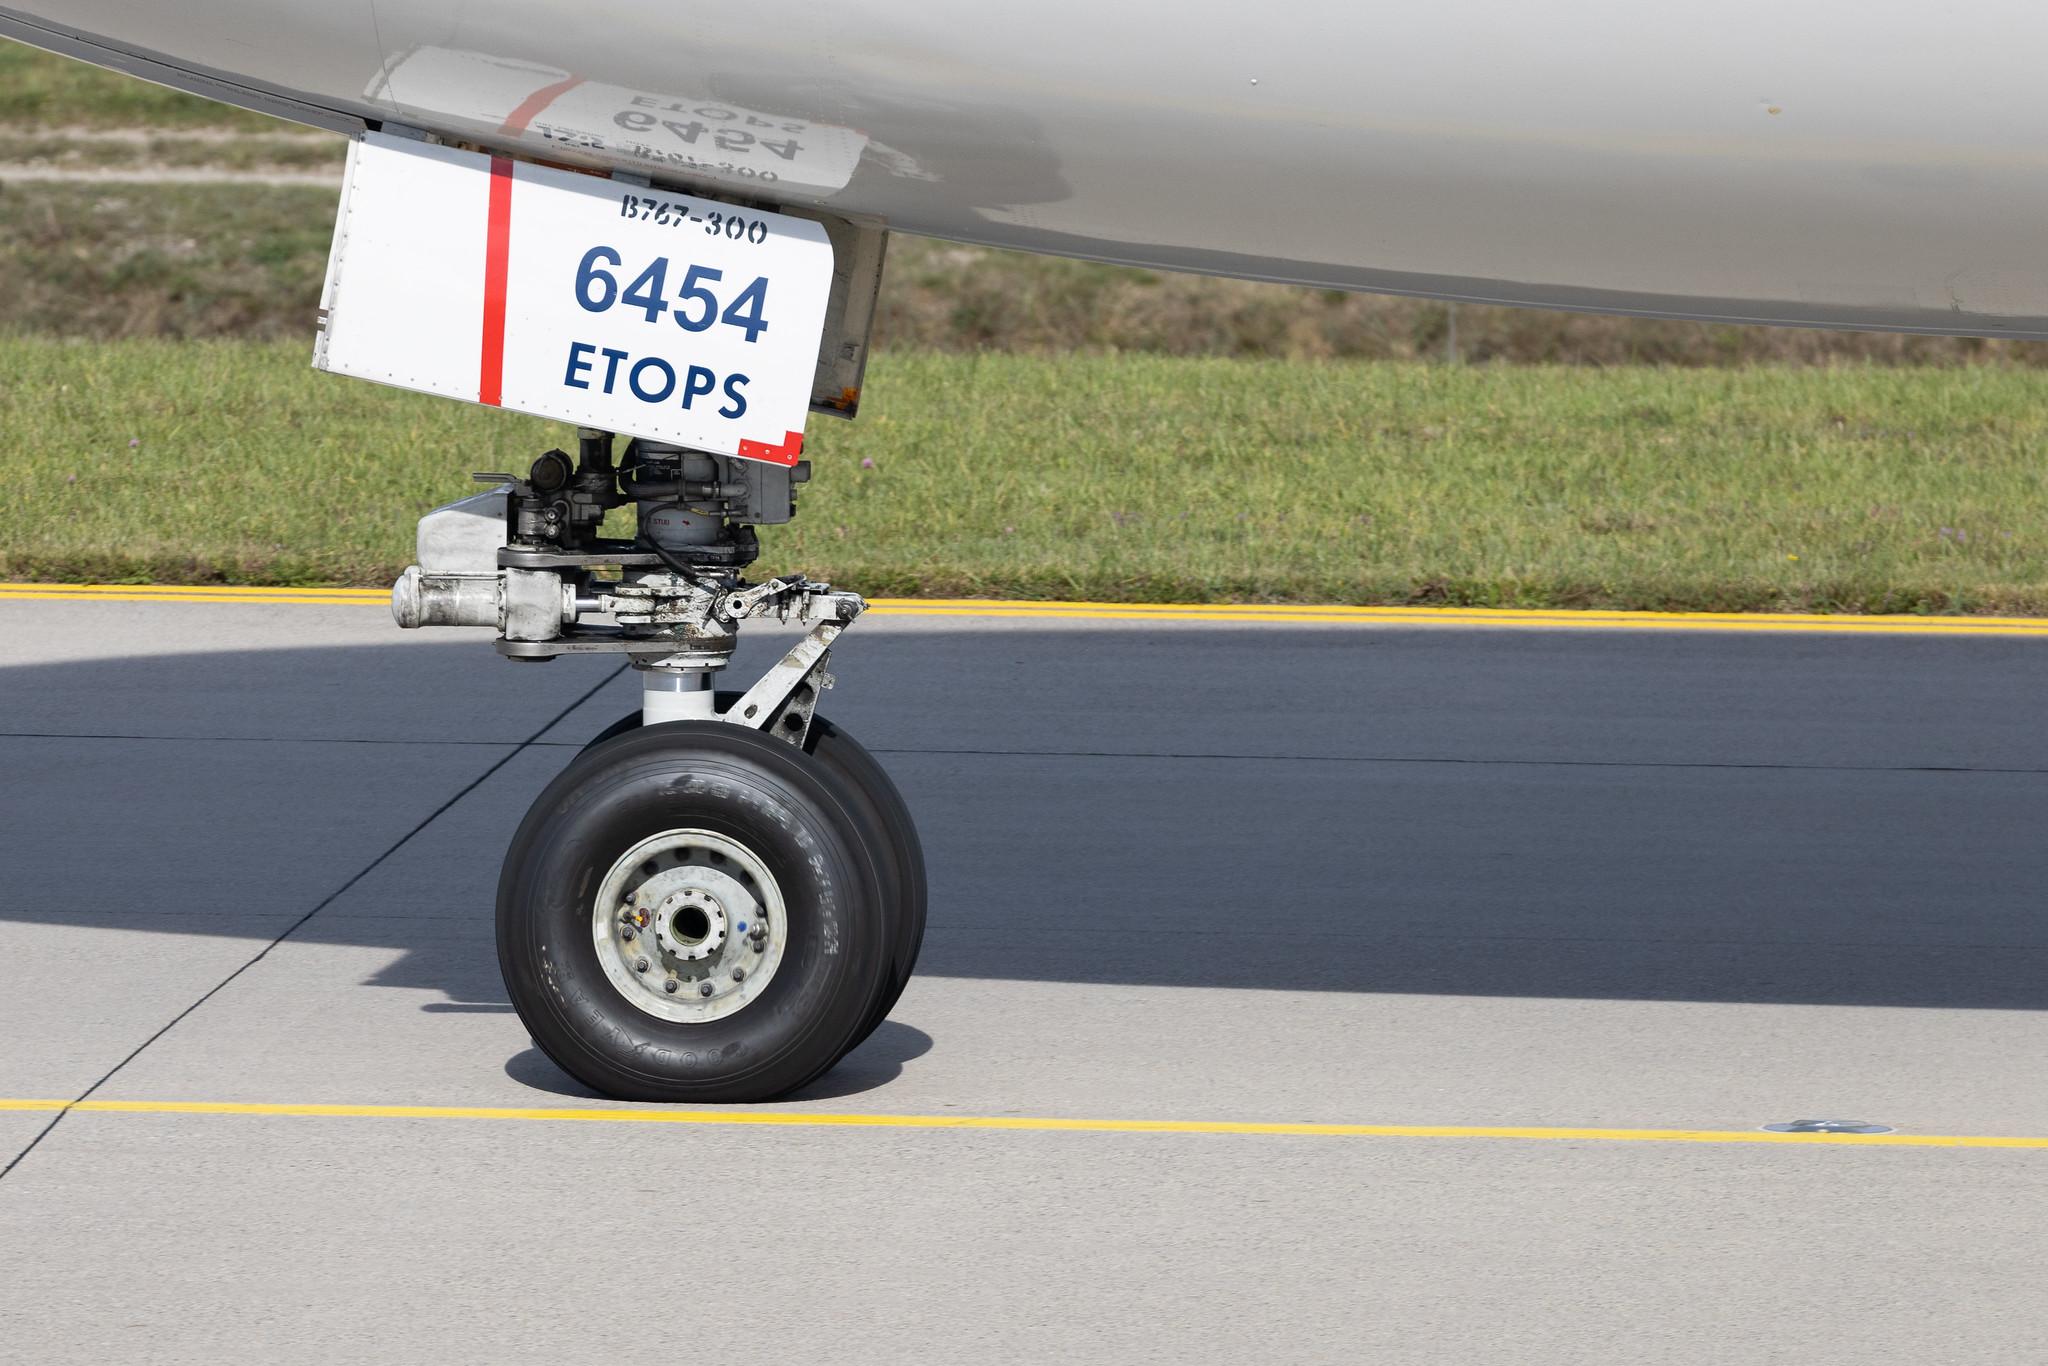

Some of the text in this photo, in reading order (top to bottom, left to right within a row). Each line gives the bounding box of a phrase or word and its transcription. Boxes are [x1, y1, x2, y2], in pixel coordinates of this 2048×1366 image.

[620, 194, 768, 245] B767-300
[575, 245, 769, 343] 6454
[564, 341, 751, 420] ETOPS
